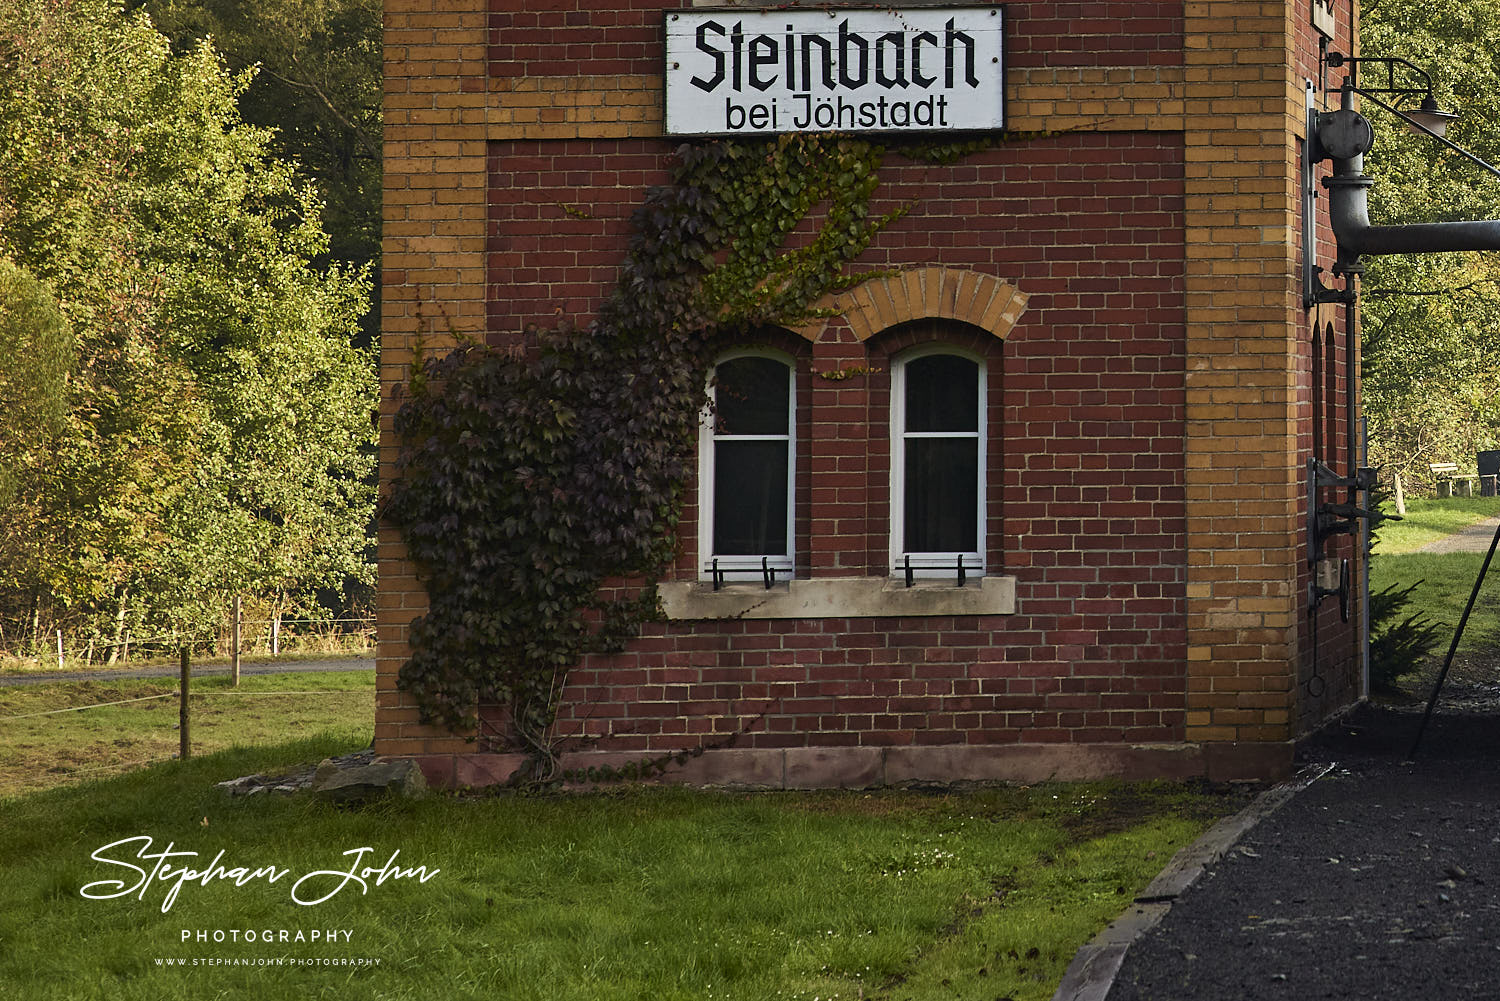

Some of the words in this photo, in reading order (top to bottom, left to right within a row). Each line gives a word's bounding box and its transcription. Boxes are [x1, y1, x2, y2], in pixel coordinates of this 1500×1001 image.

[689, 16, 980, 93] Steinbach
[725, 97, 778, 130] bei
[793, 93, 948, 129] Jöhstadt
